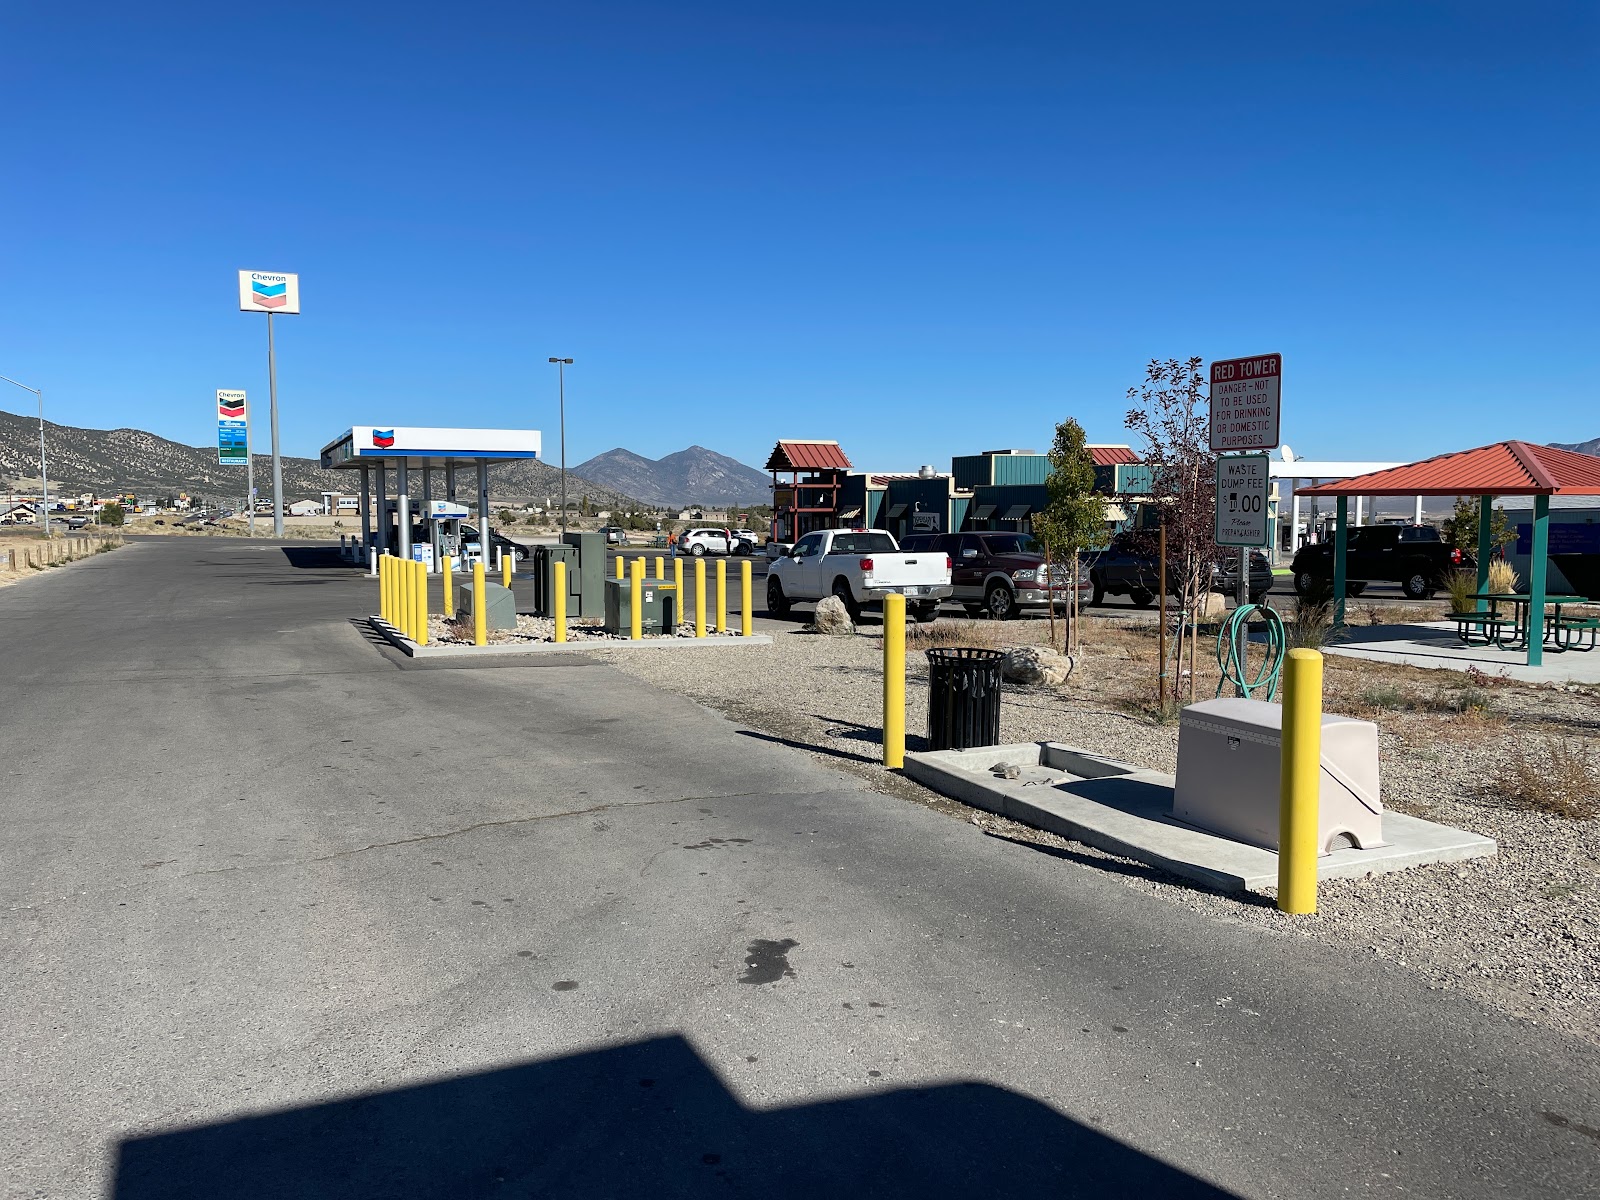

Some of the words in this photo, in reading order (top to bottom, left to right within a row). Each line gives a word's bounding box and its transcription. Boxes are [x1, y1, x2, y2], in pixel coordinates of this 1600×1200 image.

[252, 273, 286, 281] Chevron
[1214, 364, 1234, 380] RED
[1240, 358, 1276, 377] TOWER
[1219, 383, 1246, 394] DANGER
[1255, 380, 1269, 390] NOT
[1221, 398, 1229, 407] TO
[1233, 396, 1242, 406] BE
[1247, 394, 1267, 404] USED
[1216, 411, 1230, 420] FOR
[1235, 407, 1270, 419] DRINKING
[1217, 424, 1226, 433] OR
[1230, 421, 1269, 432] DOMESTIC
[1222, 434, 1263, 446] PURPOSES
[1228, 464, 1257, 475] WASTE
[1222, 479, 1244, 488] DUMP
[1248, 479, 1263, 488] FEE
[1240, 529, 1260, 537] CASHIER
